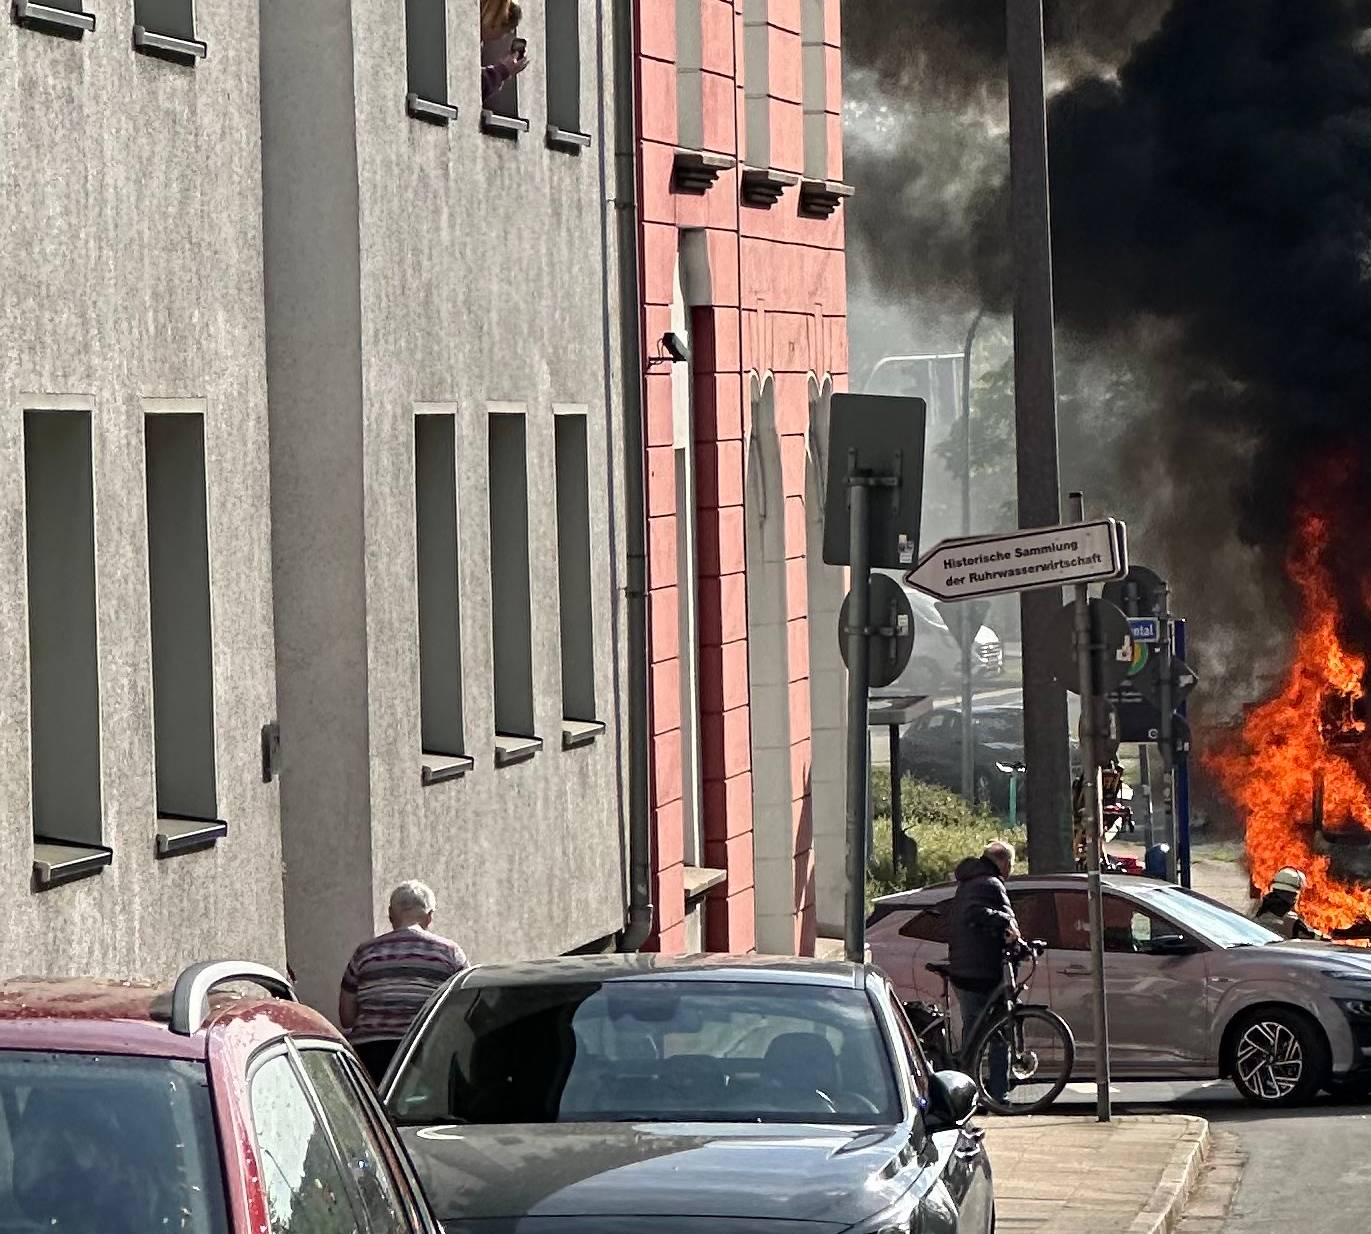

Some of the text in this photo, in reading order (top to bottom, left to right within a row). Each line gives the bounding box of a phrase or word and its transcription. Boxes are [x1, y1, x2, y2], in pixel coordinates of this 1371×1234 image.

[943, 541, 1078, 570] Historische Sammlung
[945, 553, 1102, 587] der Ruhrwasserwirtschaft
